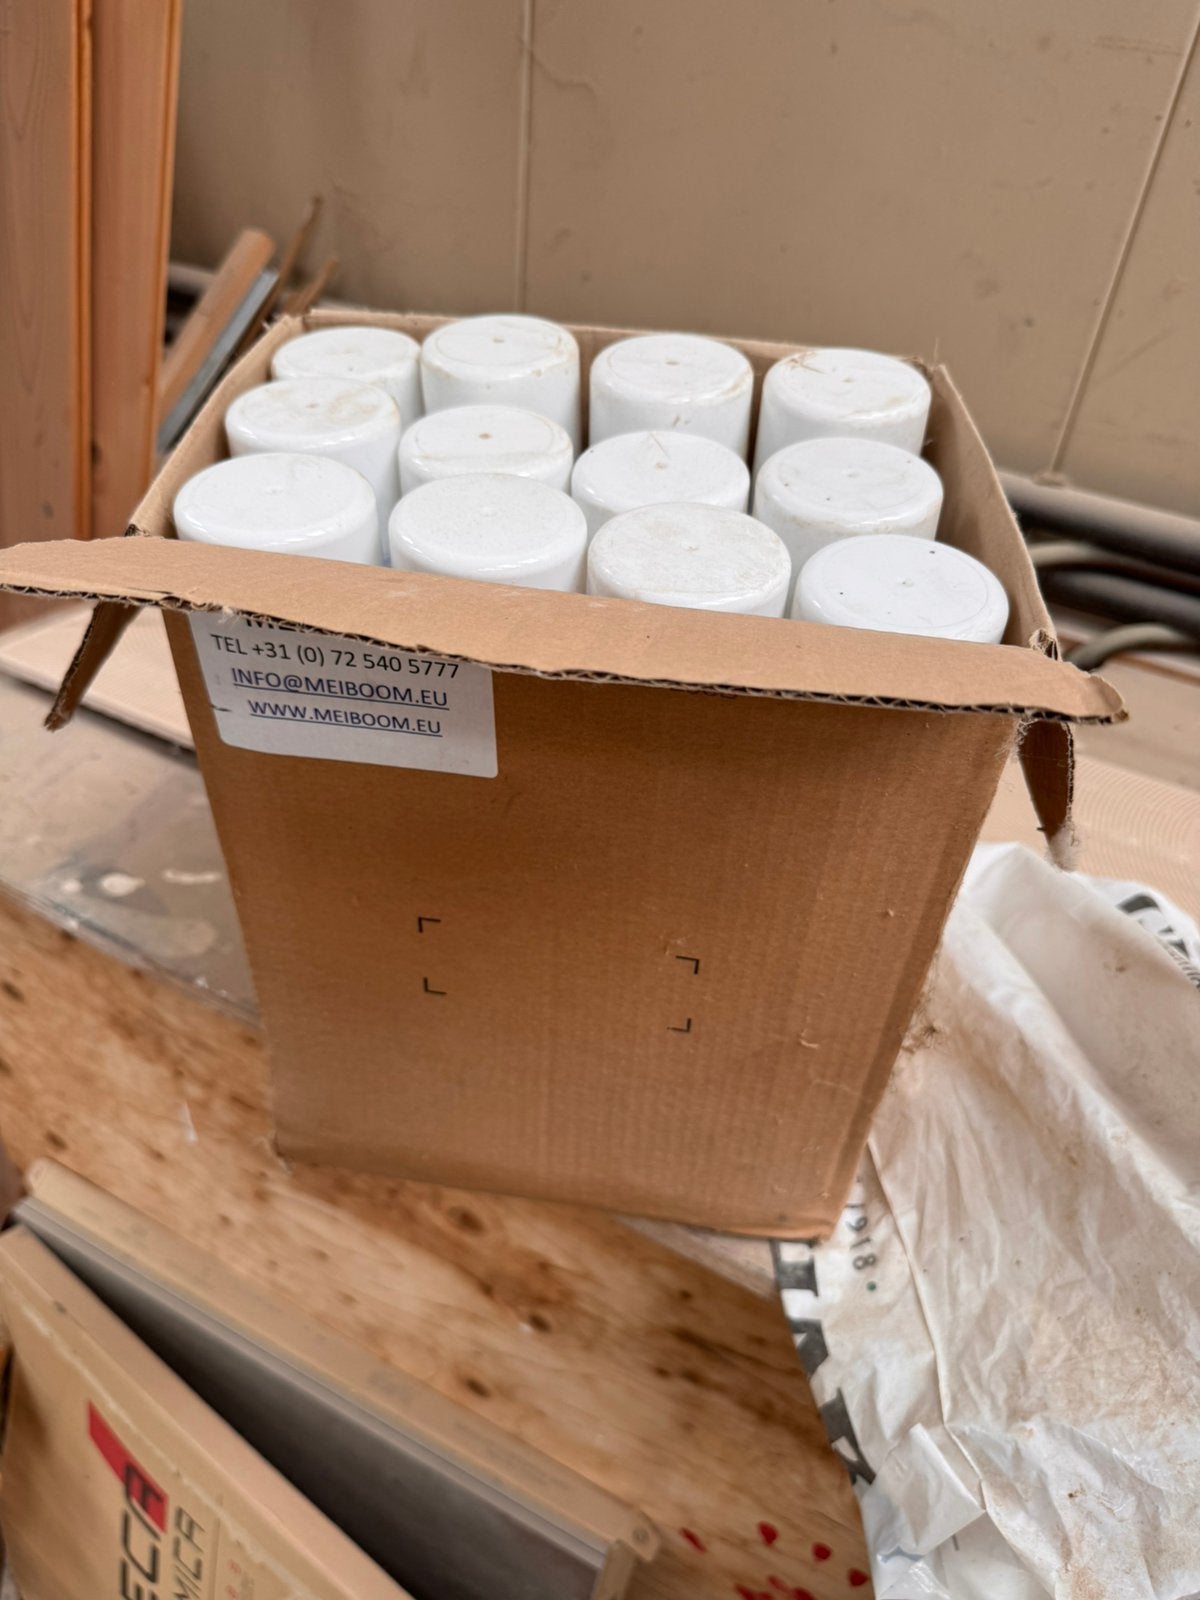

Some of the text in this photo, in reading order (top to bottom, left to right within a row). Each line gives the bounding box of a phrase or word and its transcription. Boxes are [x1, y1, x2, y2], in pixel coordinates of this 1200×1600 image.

[210, 634, 460, 679] TEL +31 (0) 72 540 5777
[231, 667, 449, 708] INFO@MEIBOOM.EU
[247, 700, 442, 735] WWW.MEIBOOM.EU
